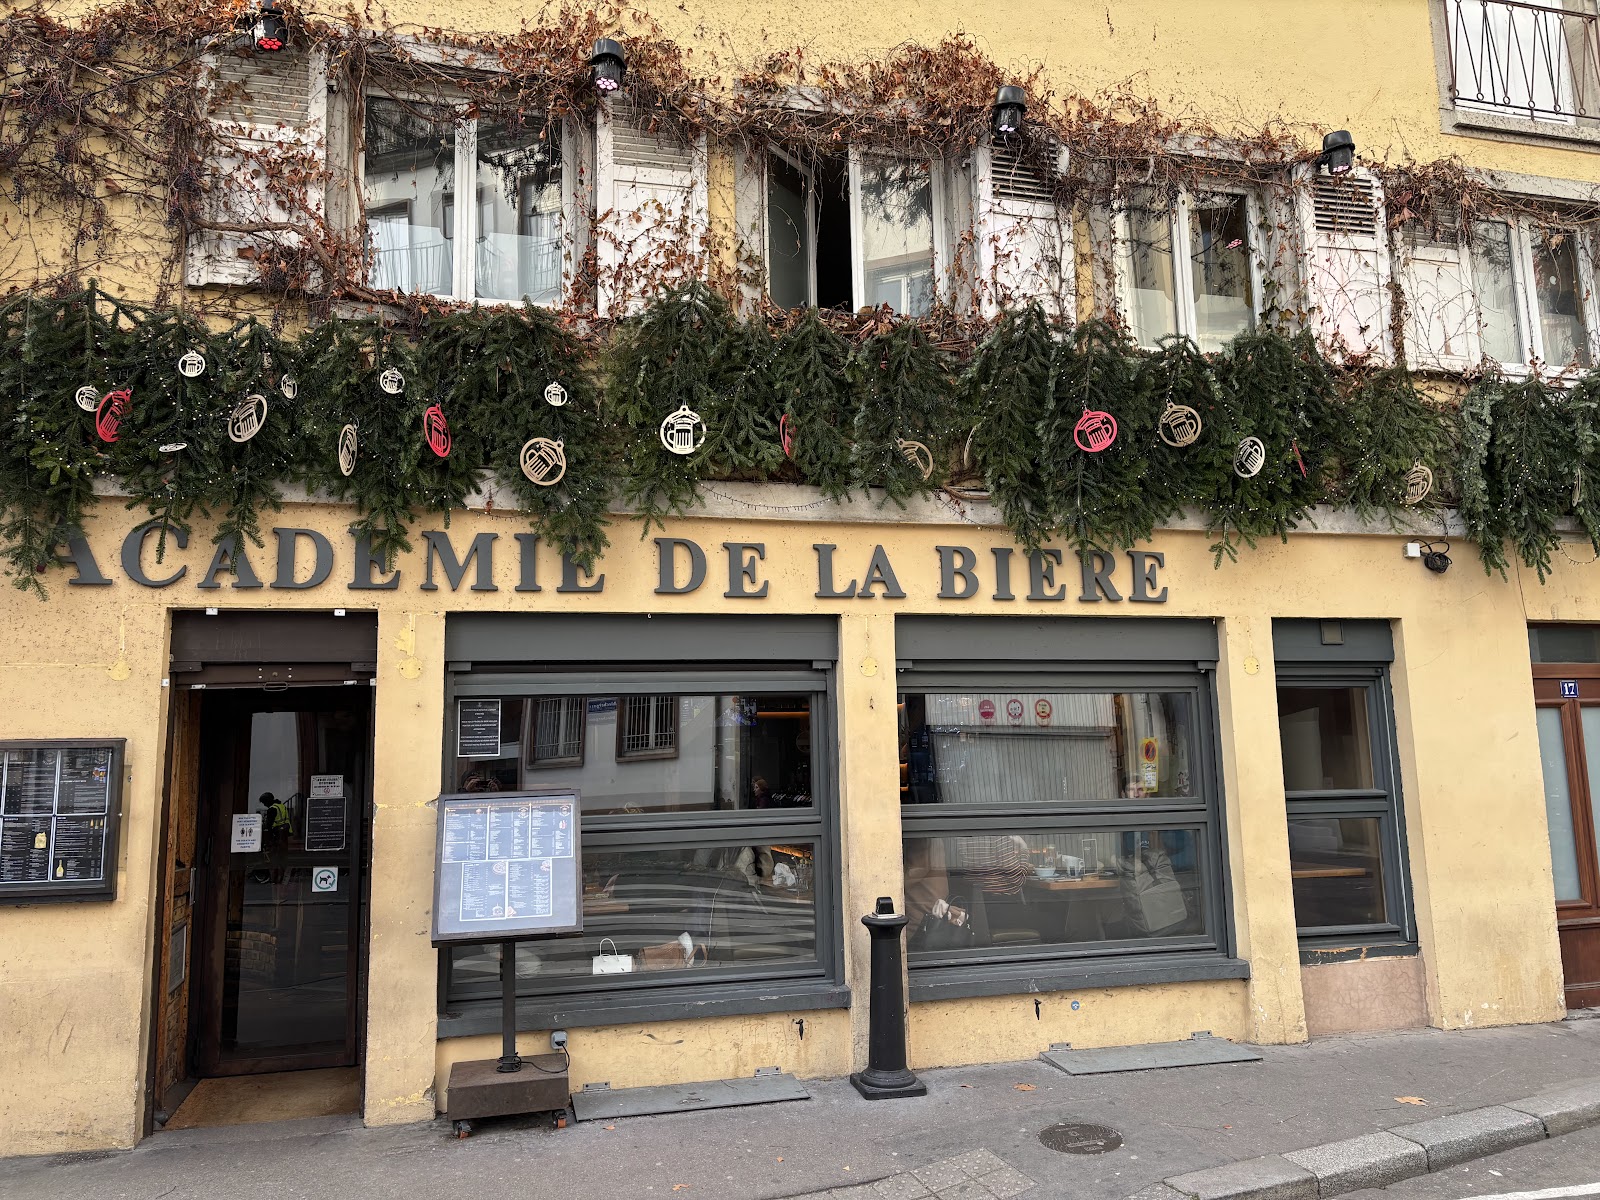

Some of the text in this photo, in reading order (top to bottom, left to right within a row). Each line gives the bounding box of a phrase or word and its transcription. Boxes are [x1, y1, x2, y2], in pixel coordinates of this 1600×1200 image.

[57, 519, 1169, 603] ACADEMIE DE LA BIERE
[1563, 682, 1575, 695] 17
